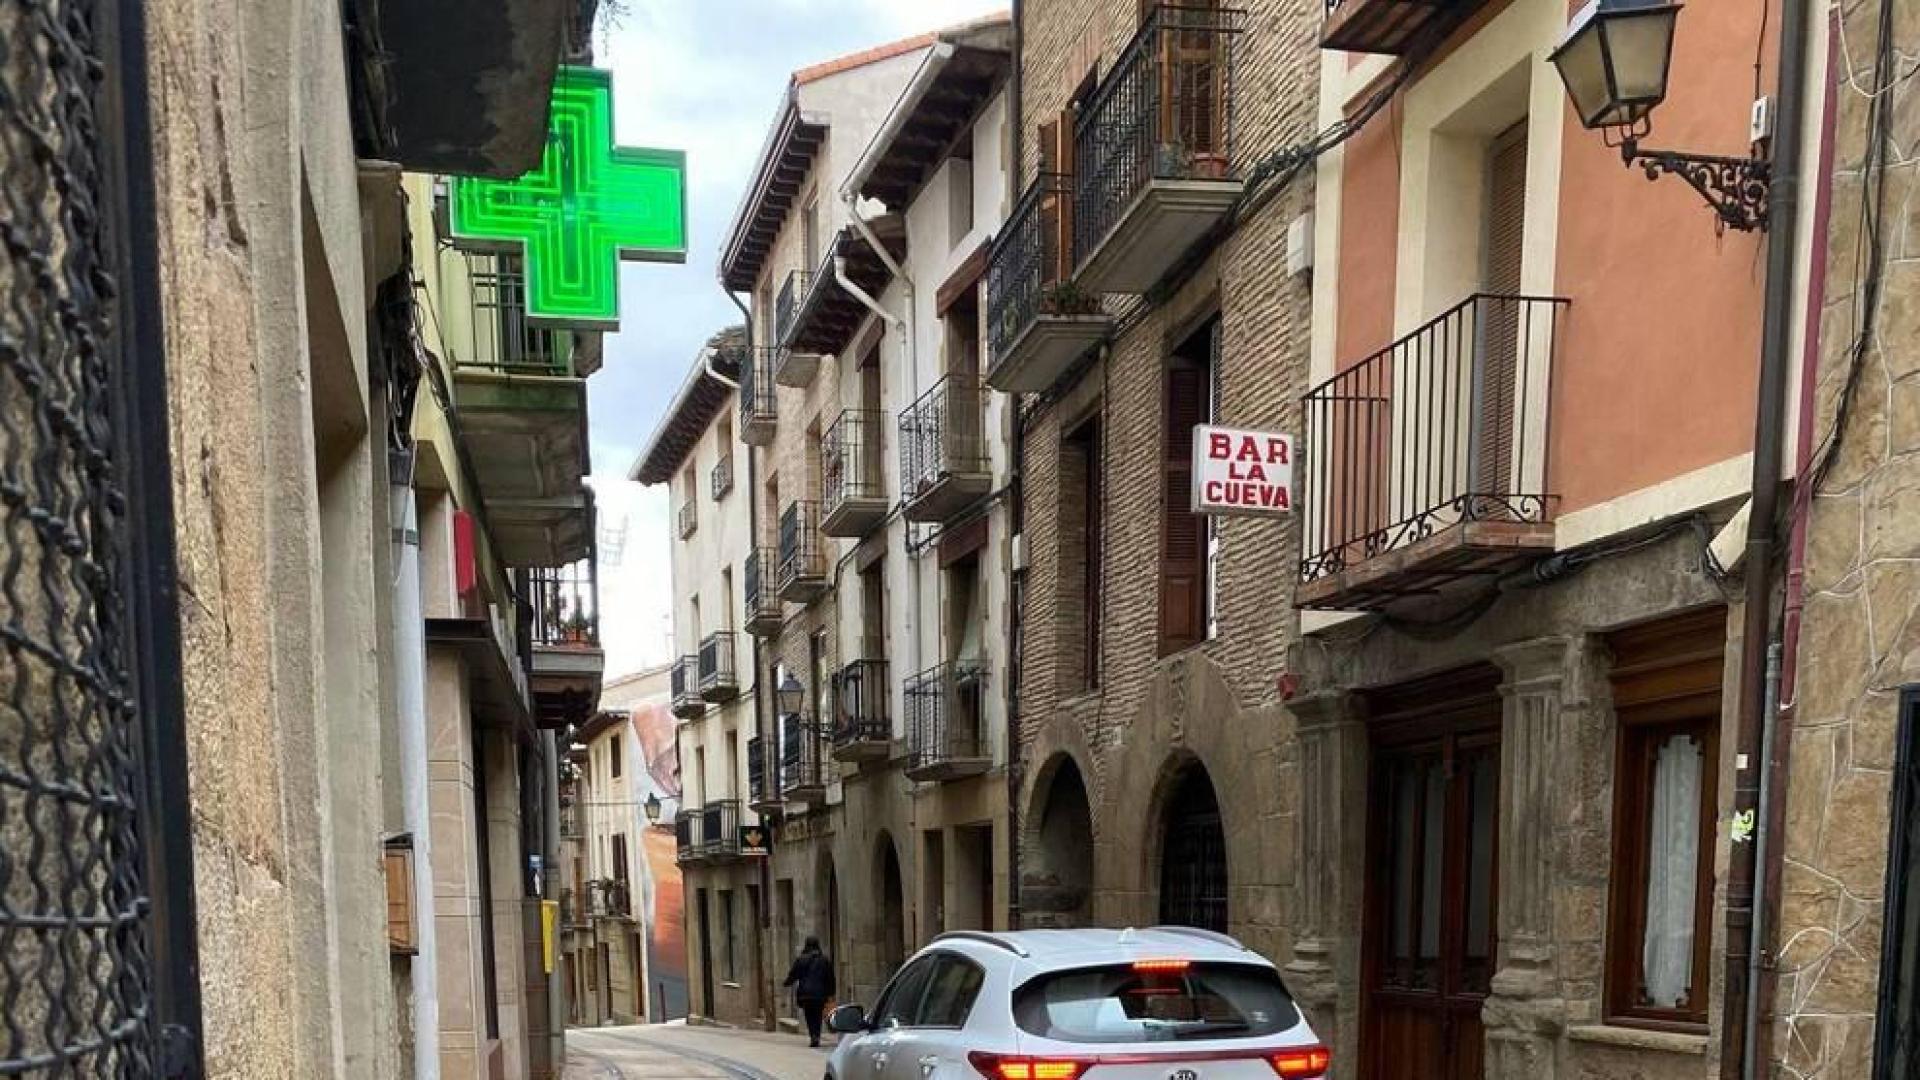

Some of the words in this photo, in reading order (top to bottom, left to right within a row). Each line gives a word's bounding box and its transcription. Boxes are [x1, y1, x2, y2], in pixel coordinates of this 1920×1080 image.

[1209, 433, 1288, 464] BAR
[1229, 462, 1267, 481] LA
[1207, 481, 1289, 508] CUEVA
